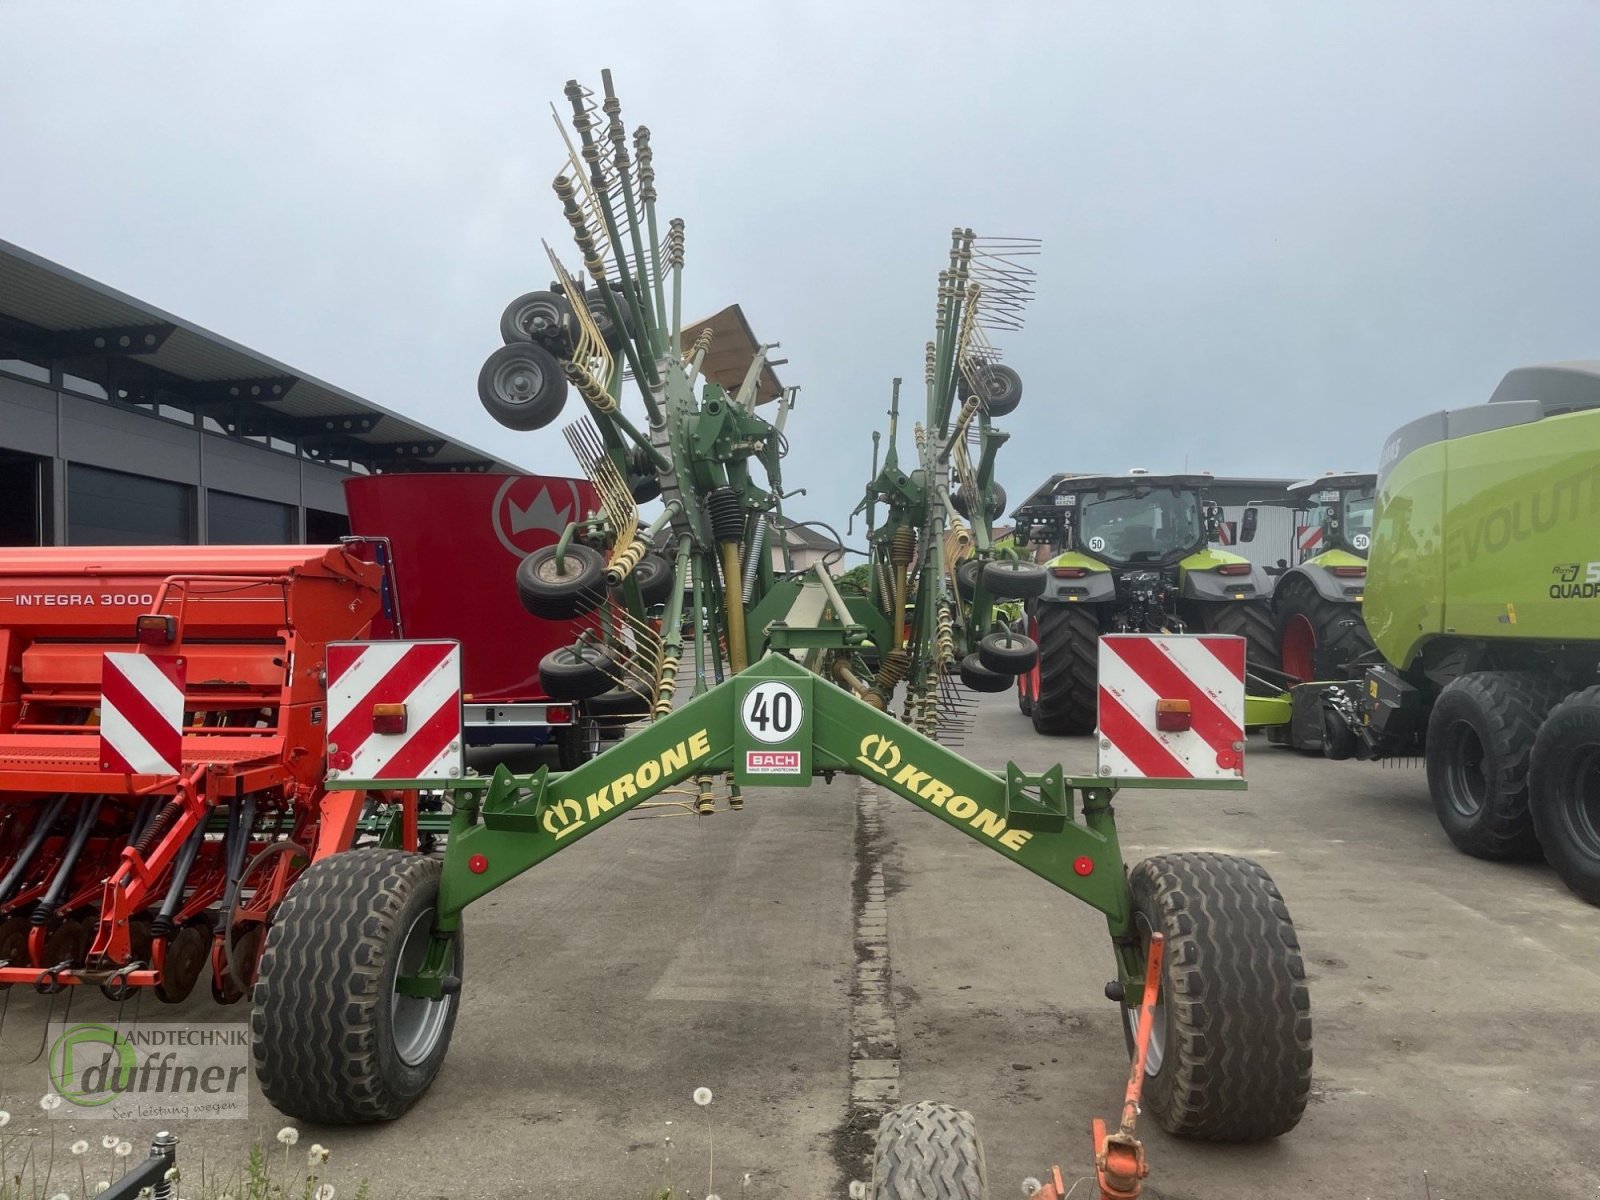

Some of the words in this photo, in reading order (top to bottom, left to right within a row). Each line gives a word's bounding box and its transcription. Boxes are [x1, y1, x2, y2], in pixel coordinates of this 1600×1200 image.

[1091, 539, 1102, 550] 50
[1356, 536, 1367, 547] 50
[15, 594, 95, 606] INTEGRA
[101, 594, 153, 606] 3000
[750, 692, 793, 732] 40
[752, 755, 795, 766] BACH
[585, 728, 711, 821] KRONE
[892, 763, 1034, 852] KRONE
